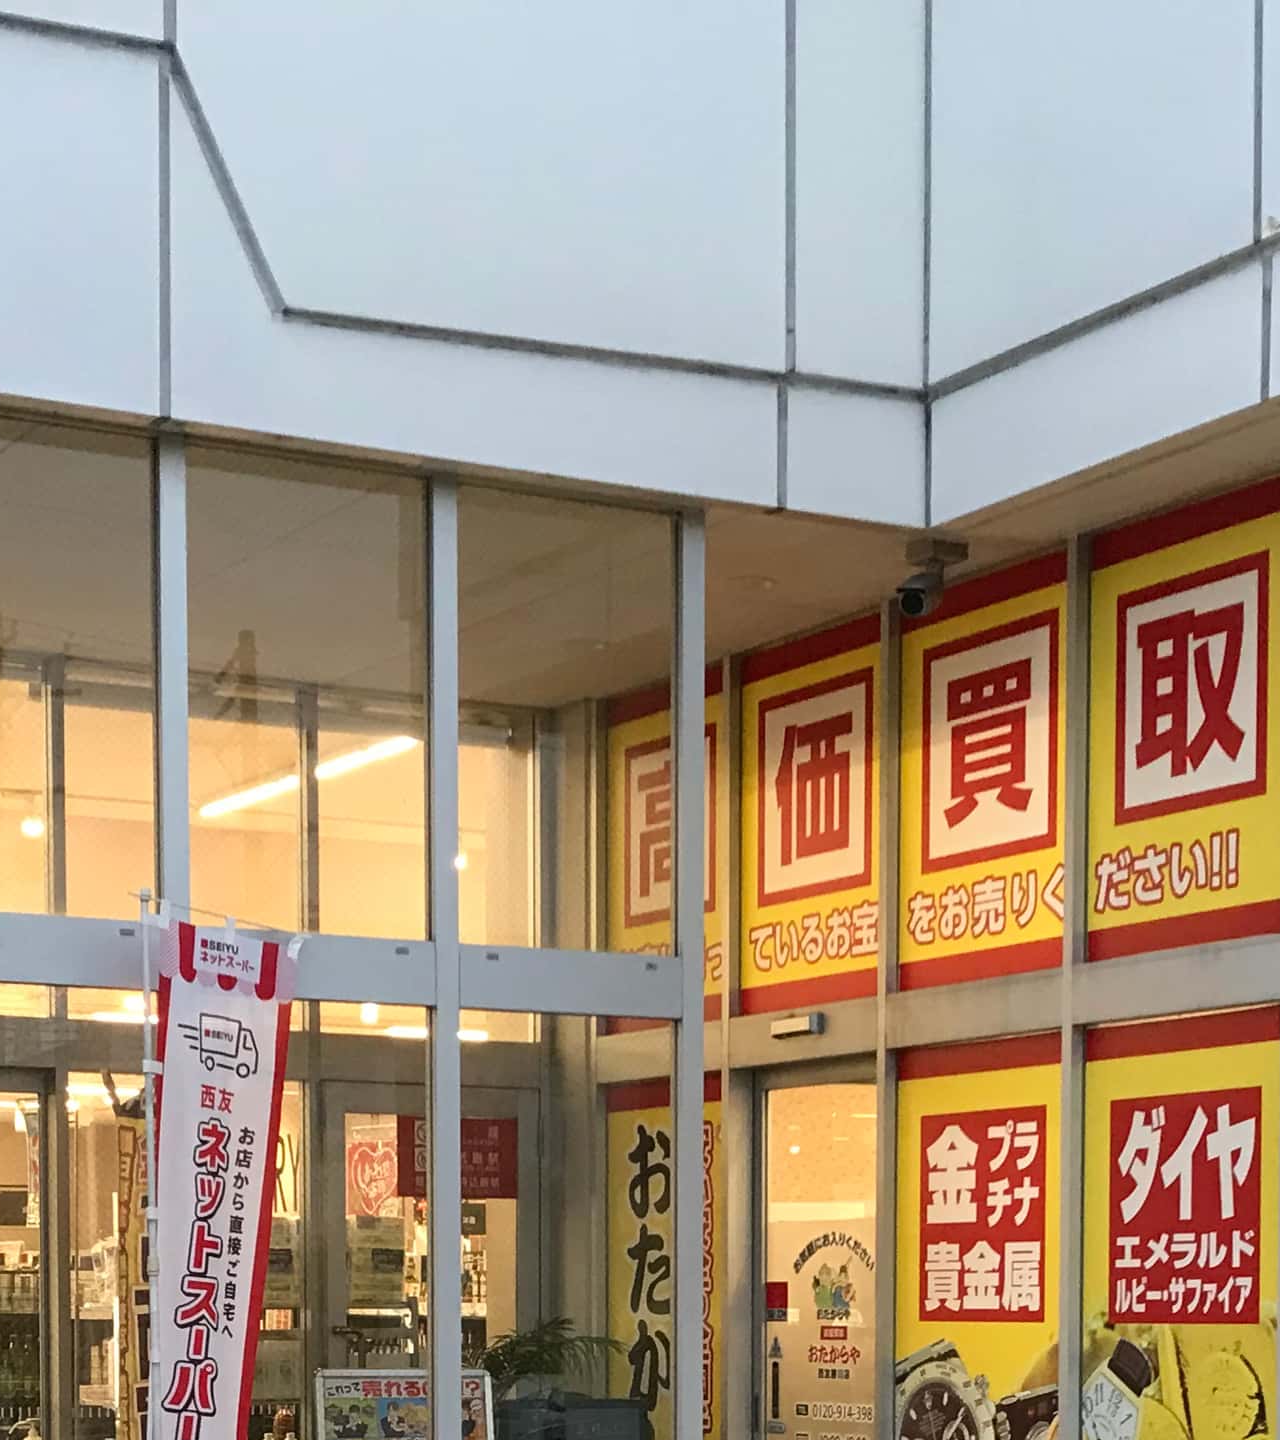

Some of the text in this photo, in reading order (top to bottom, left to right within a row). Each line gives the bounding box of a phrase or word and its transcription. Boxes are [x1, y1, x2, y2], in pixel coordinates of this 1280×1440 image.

[201, 951, 255, 972] ネットスーパー
[209, 940, 239, 954] SEIYU
[211, 1030, 234, 1042] SEIYU
[201, 1084, 234, 1113] 西友
[926, 1124, 979, 1225] 金
[1118, 1104, 1256, 1225] ダイヤ
[221, 1127, 256, 1338] お店から直接ご自宅へ
[1115, 1230, 1255, 1270] エメラルド
[924, 1240, 1041, 1312] 貴金属
[1115, 1276, 1253, 1315] ルビー・サファイア
[808, 1344, 861, 1365] おたからや
[812, 1404, 873, 1422] 0120-914-398
